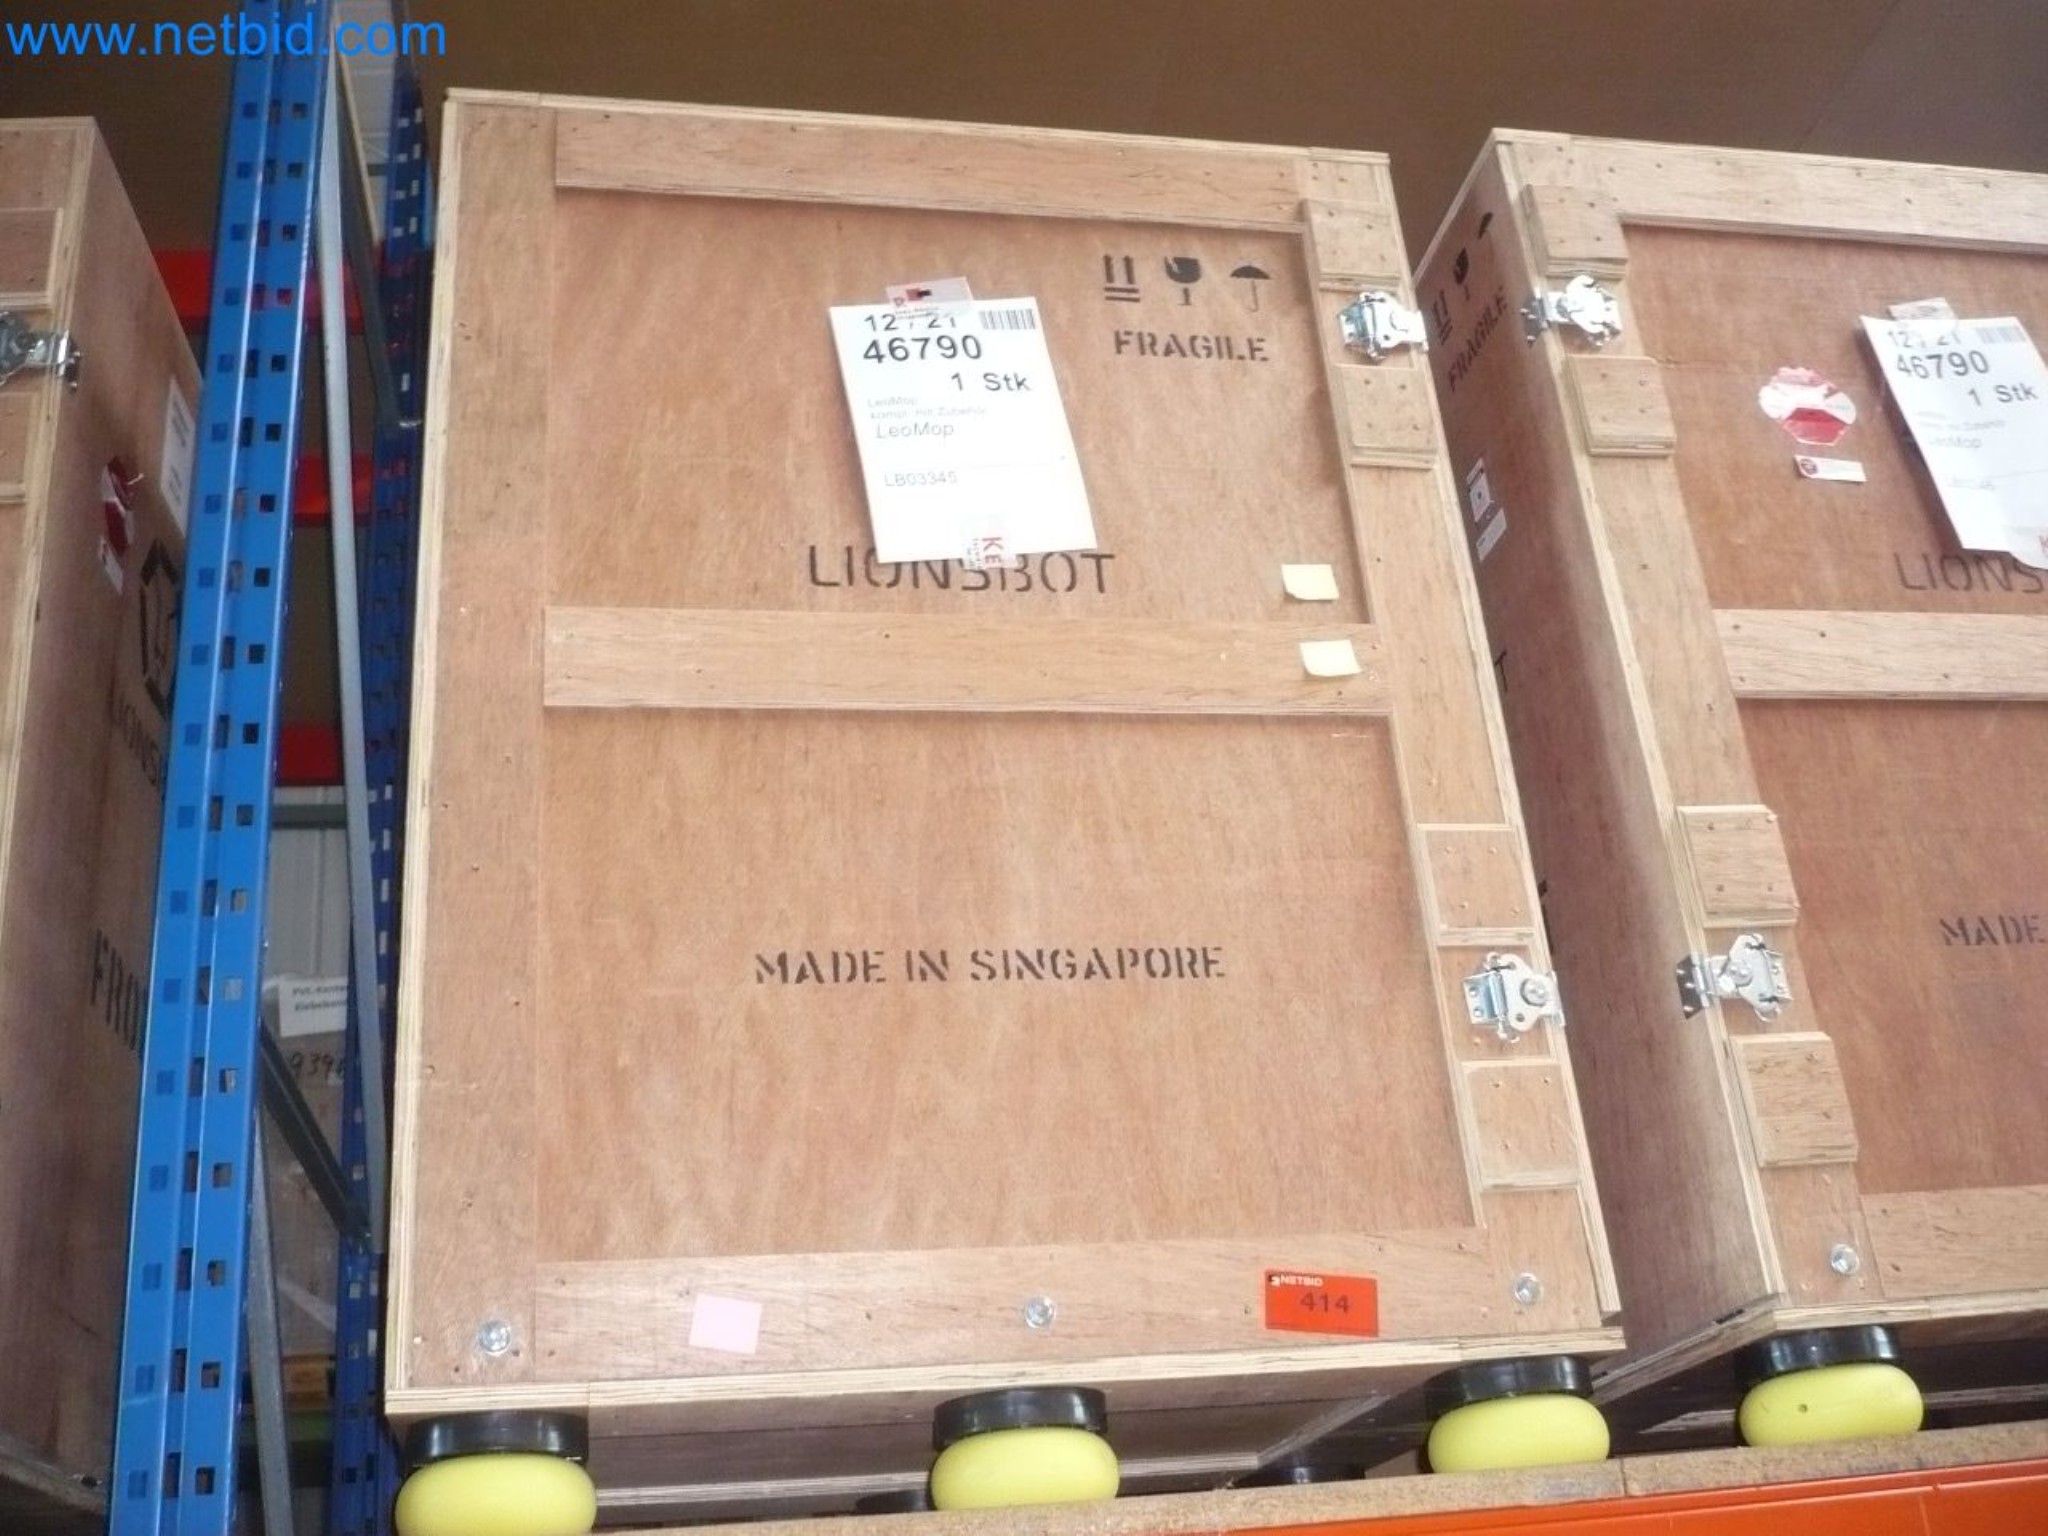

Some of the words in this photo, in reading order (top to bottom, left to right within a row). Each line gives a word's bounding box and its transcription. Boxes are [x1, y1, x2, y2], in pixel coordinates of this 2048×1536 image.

[863, 335, 982, 363] 46790
[1114, 329, 1269, 362] FRAGILE
[1446, 285, 1508, 393] FRAGILE
[1897, 350, 1989, 379] 46790
[951, 372, 964, 391] 1
[983, 372, 1031, 391] Stk
[1968, 388, 1982, 406] 1
[1994, 382, 2039, 403] Stk
[876, 421, 954, 440] LeoMop
[809, 545, 1115, 593] LIONSBOT
[1939, 914, 2046, 946] MADE
[755, 950, 886, 985] MADE
[906, 949, 948, 982] IN
[970, 946, 1226, 982] SINGAPORE
[1300, 1292, 1350, 1313] 414
